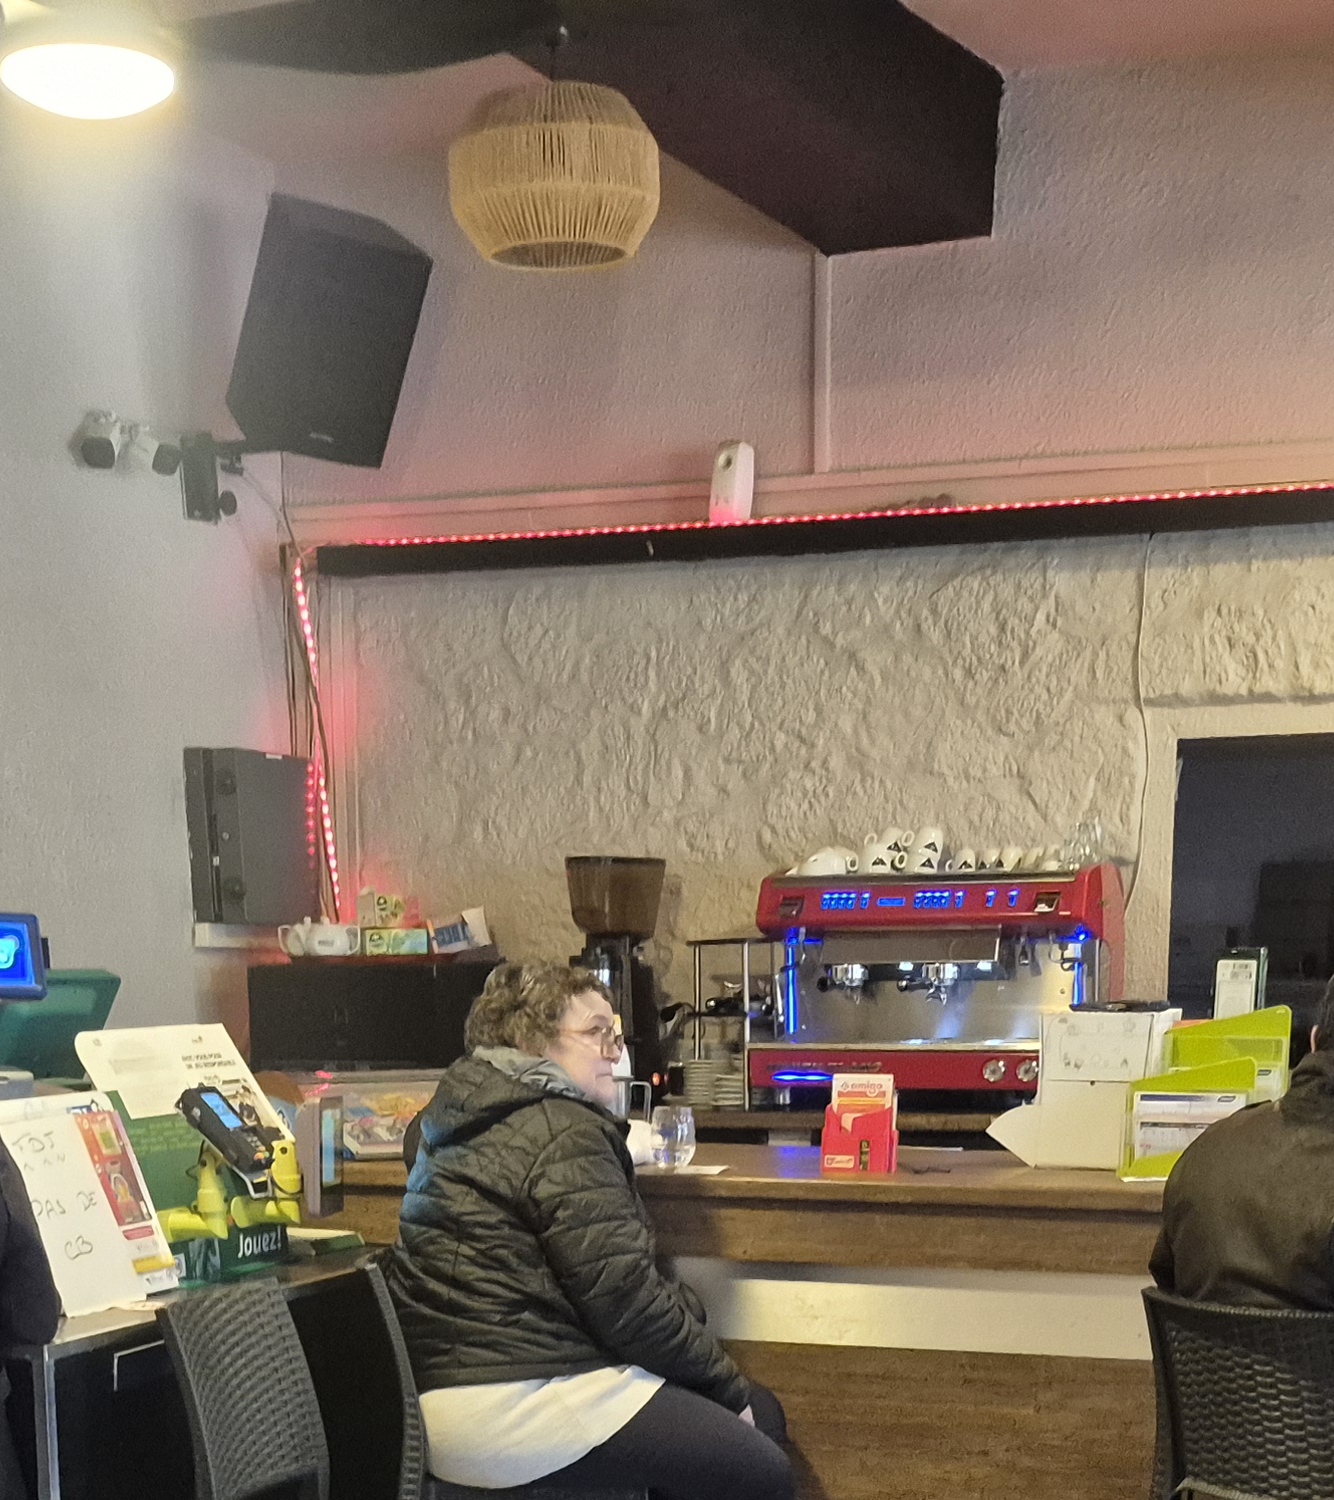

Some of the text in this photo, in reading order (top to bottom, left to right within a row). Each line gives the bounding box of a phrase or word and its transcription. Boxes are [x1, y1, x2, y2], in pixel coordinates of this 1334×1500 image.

[851, 1081, 883, 1094] amigo
[64, 1235, 94, 1261] CB
[237, 1224, 282, 1259] Jouez!
